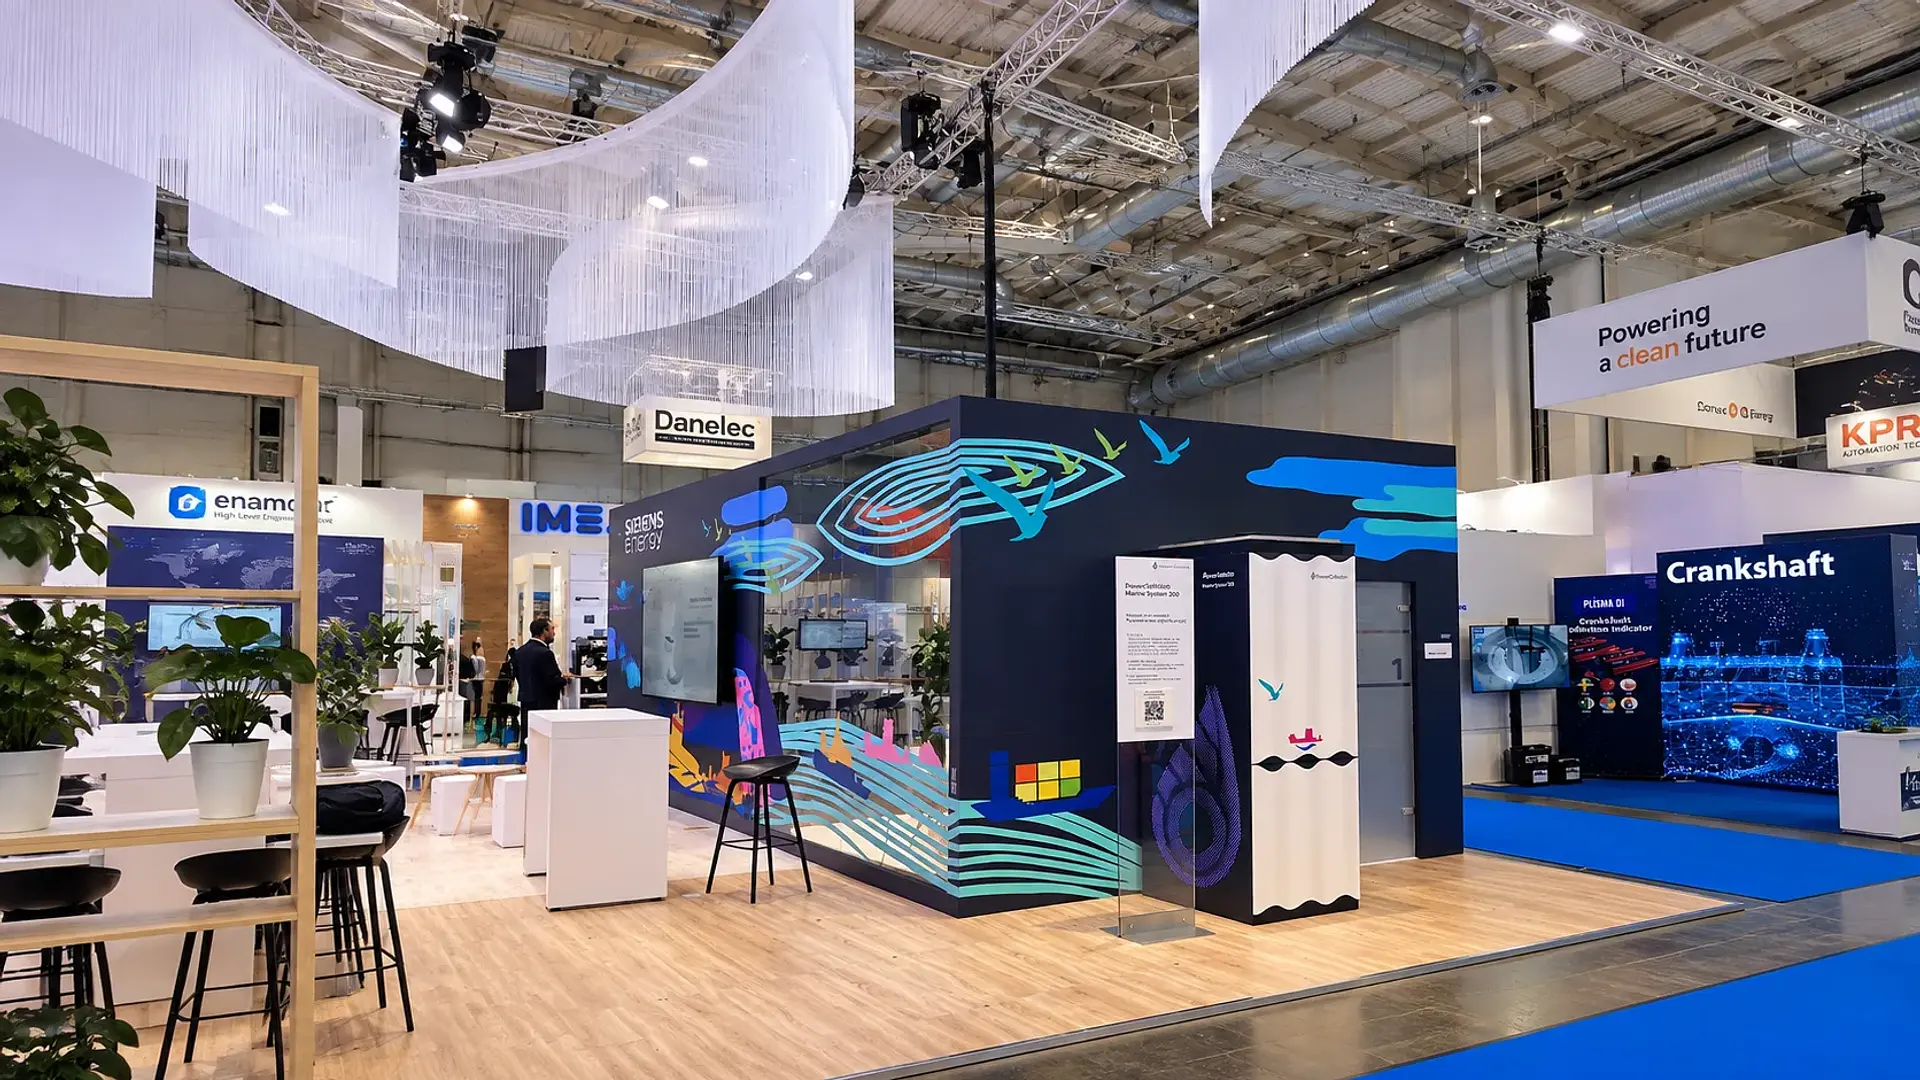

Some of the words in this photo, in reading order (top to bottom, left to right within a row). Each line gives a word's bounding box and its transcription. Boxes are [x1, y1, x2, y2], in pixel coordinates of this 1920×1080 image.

[1598, 305, 1710, 347] Powering
[1599, 357, 1611, 372] a
[1616, 342, 1679, 368] clean
[1684, 322, 1766, 353] future
[655, 409, 755, 437] Danelec
[1842, 414, 1920, 447] KPR
[1843, 443, 1900, 457] AUTOMATION
[521, 501, 610, 534] IME
[624, 531, 663, 554] energy
[1666, 550, 1835, 584] Crankshaft
